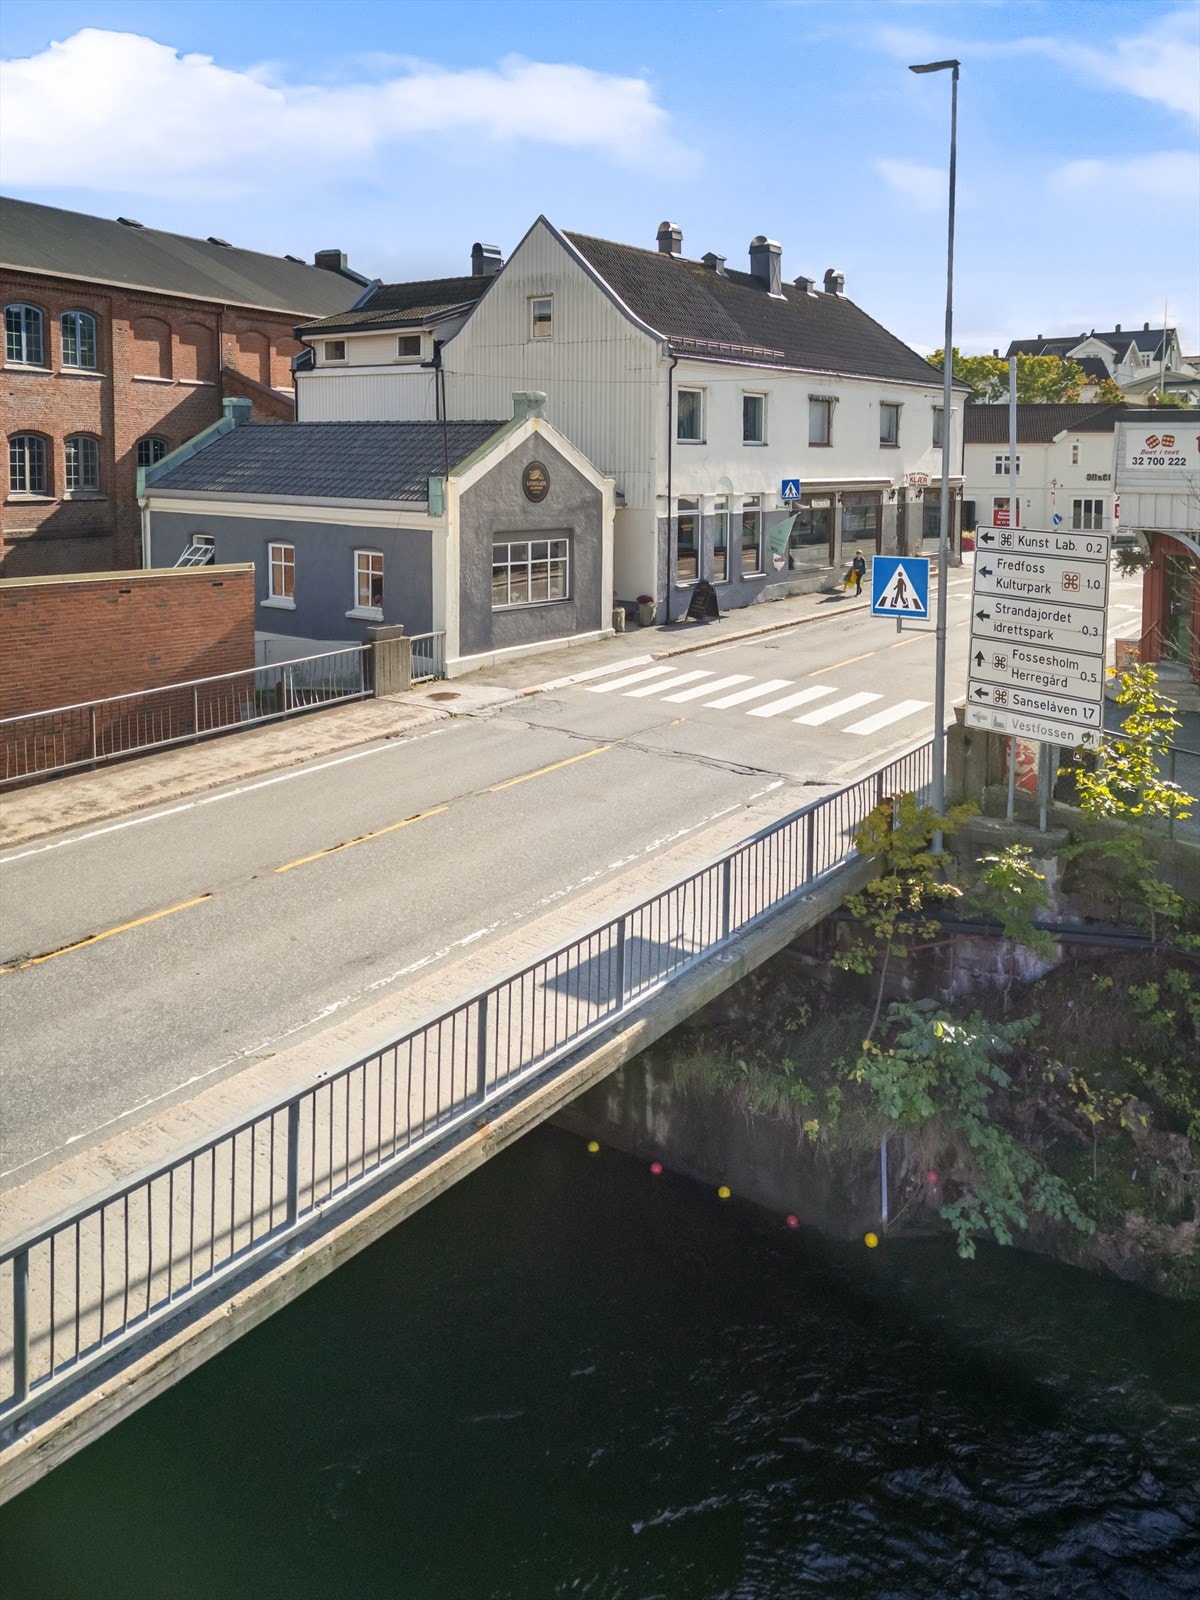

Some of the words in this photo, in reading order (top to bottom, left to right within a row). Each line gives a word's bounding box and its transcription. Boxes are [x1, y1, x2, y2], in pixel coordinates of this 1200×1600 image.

[1132, 456, 1144, 465] 32
[1147, 457, 1165, 466] 700
[1168, 457, 1187, 466] 222
[1018, 535, 1050, 549] Kunst
[997, 558, 1045, 574] Fredfoss
[996, 577, 1052, 595] Kulturpark
[995, 602, 1072, 623] Strandajordet
[993, 621, 1054, 640] idrettspark
[1012, 649, 1079, 670] Fossesholm
[1011, 668, 1068, 688] Herregård
[1012, 694, 1078, 716] Sanselåven
[1012, 718, 1075, 741] Vestfossen
